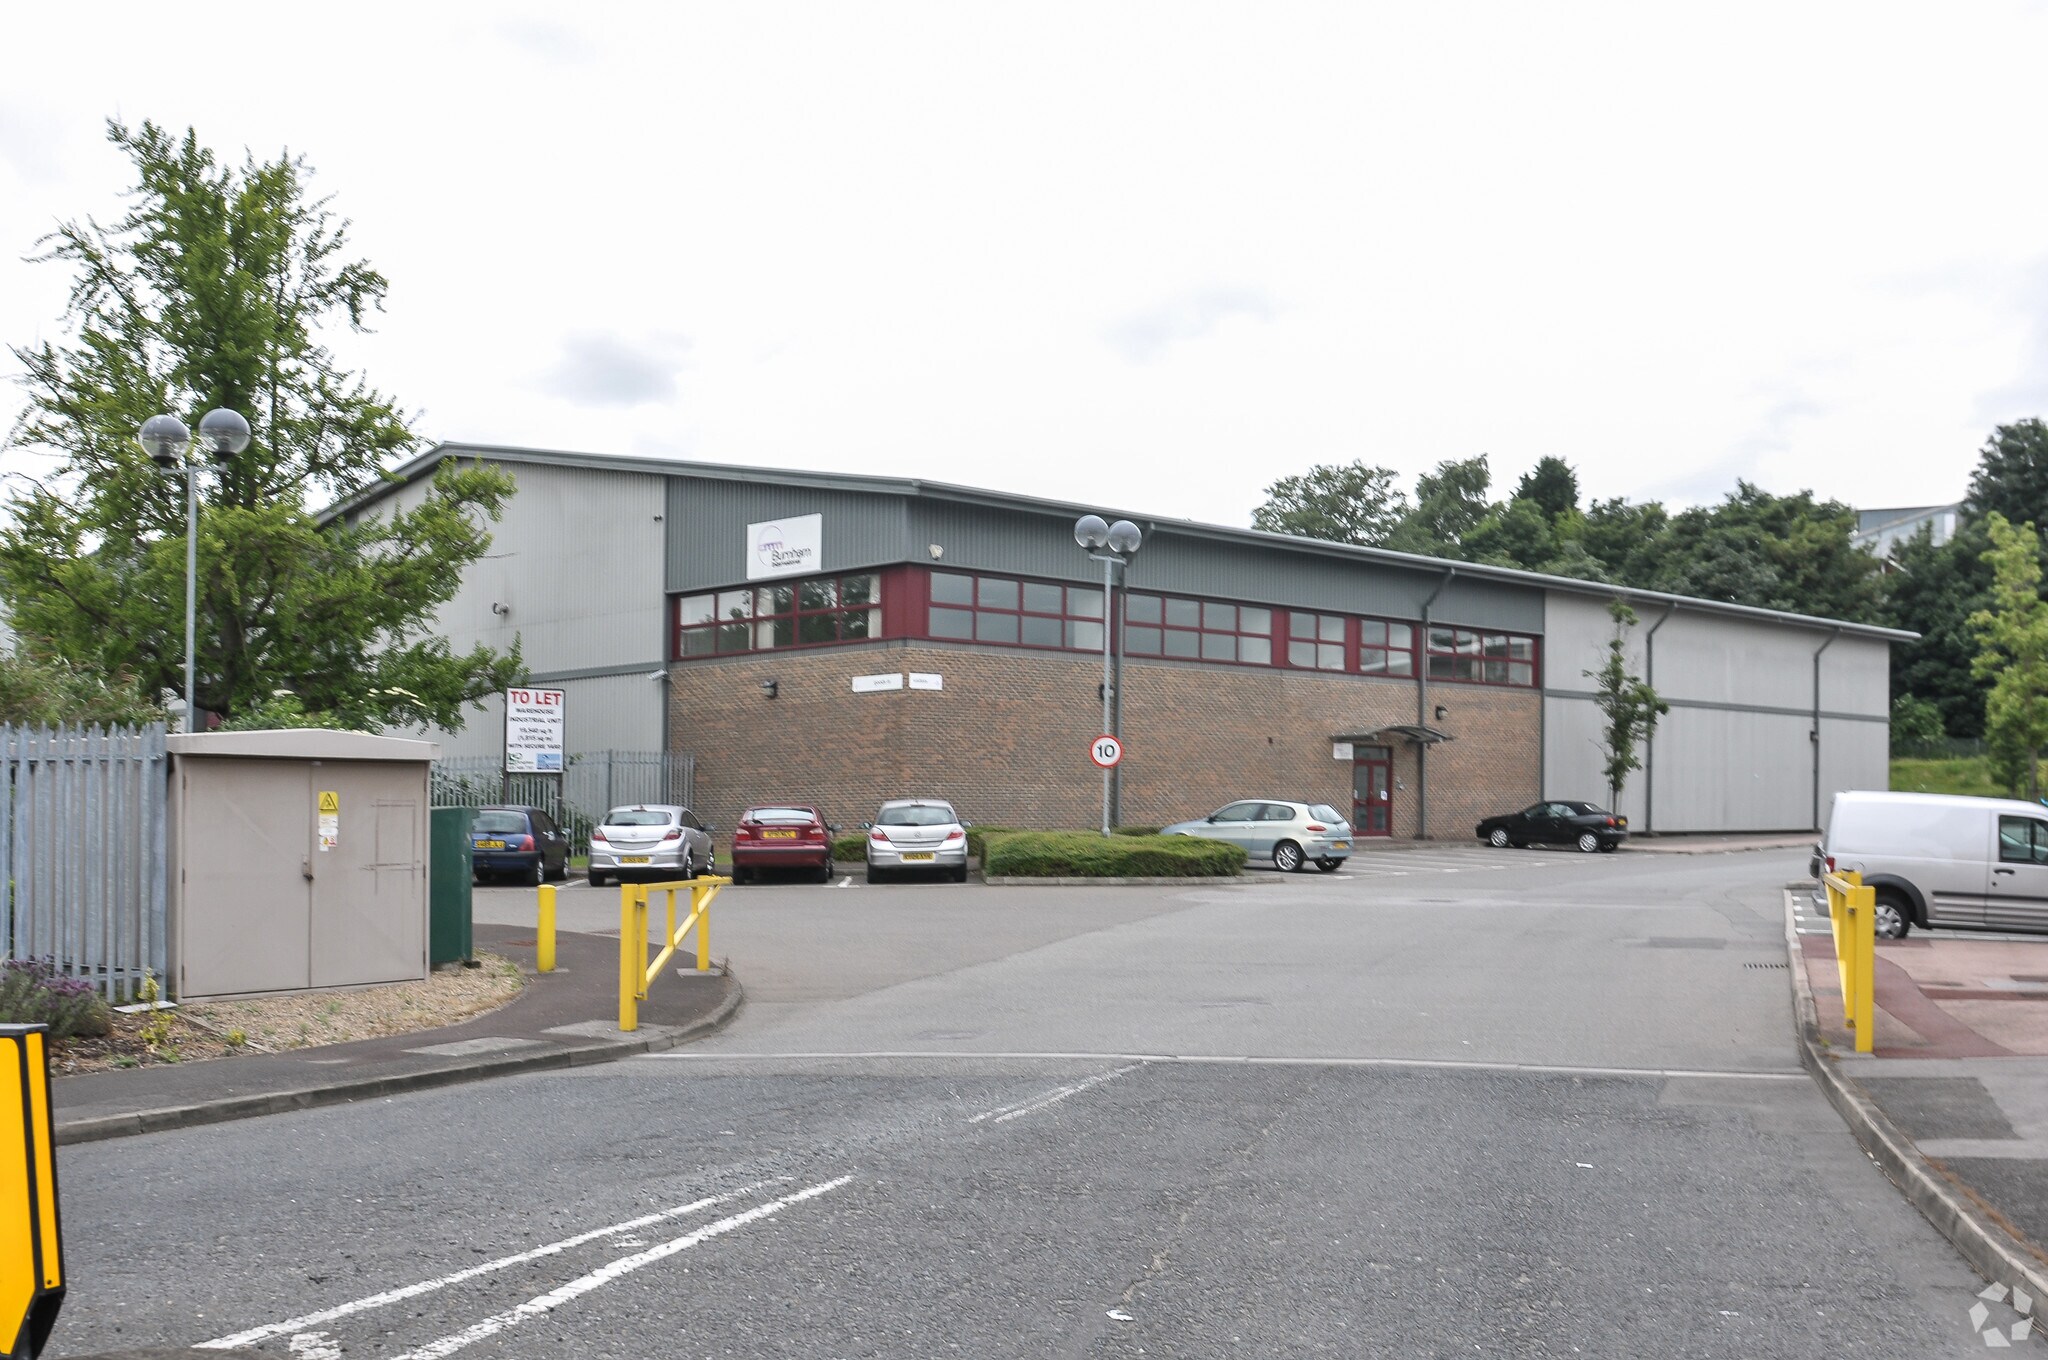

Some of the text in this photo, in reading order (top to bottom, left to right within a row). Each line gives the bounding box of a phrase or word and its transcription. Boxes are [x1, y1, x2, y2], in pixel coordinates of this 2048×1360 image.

[771, 547, 812, 561] Burnham
[510, 691, 561, 706] TO LET
[509, 716, 546, 724] INDUSTRIAL
[1096, 744, 1115, 758] 10
